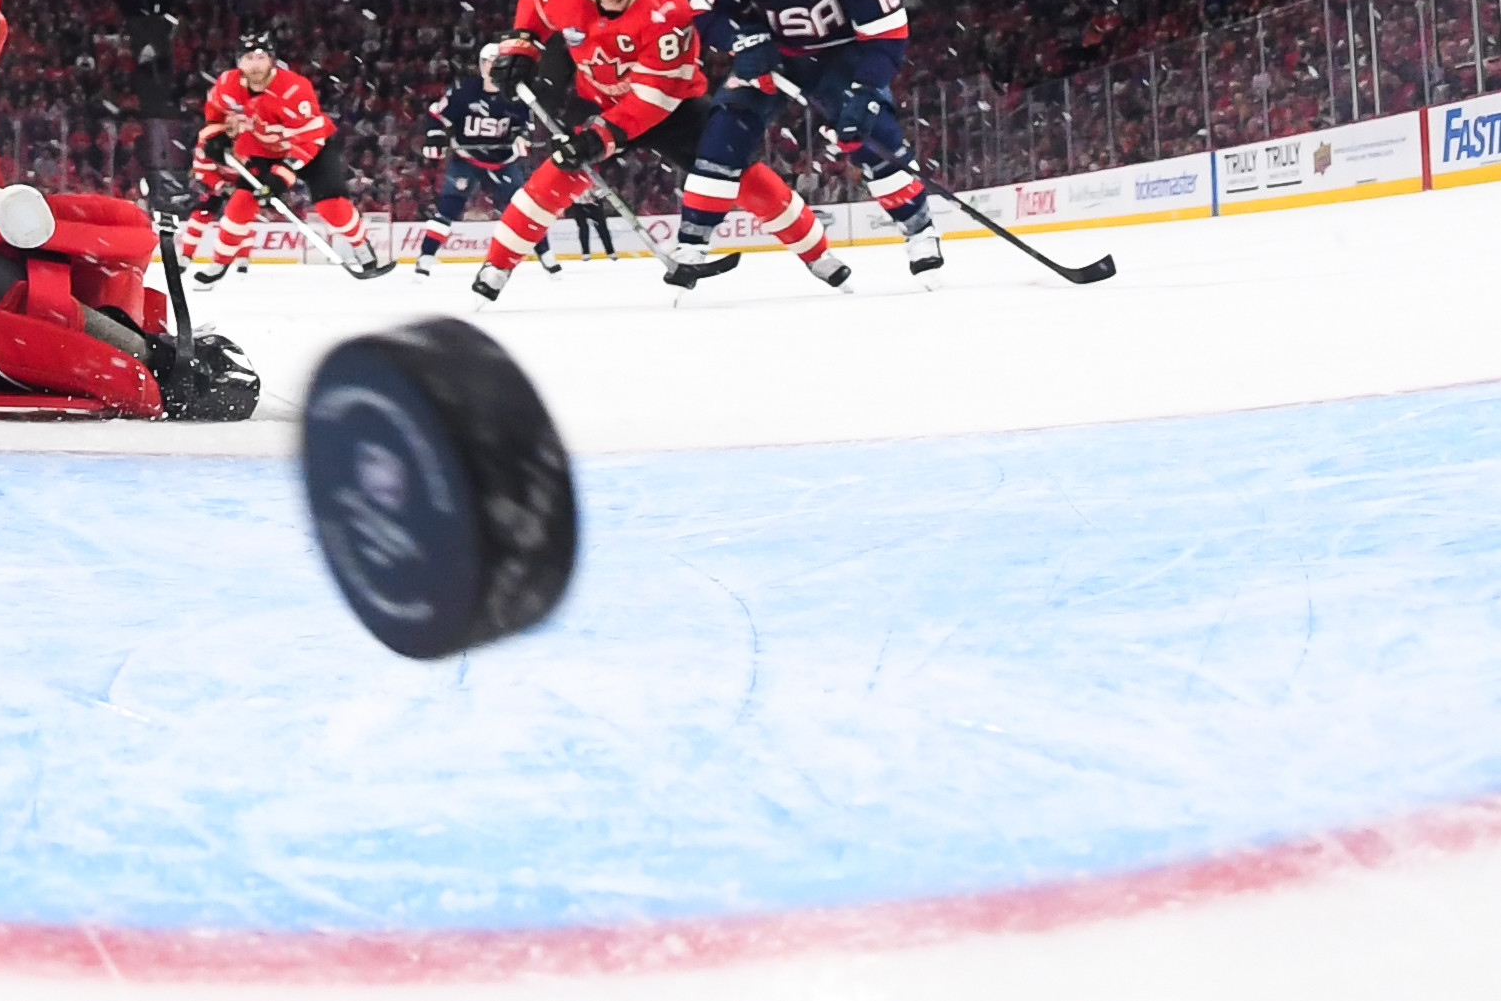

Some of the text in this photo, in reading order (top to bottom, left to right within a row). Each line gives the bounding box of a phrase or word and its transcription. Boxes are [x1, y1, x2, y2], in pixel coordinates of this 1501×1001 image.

[616, 34, 635, 53] C
[658, 25, 694, 61] 87
[1443, 107, 1501, 162] FAST
[1265, 141, 1301, 169] TRULY
